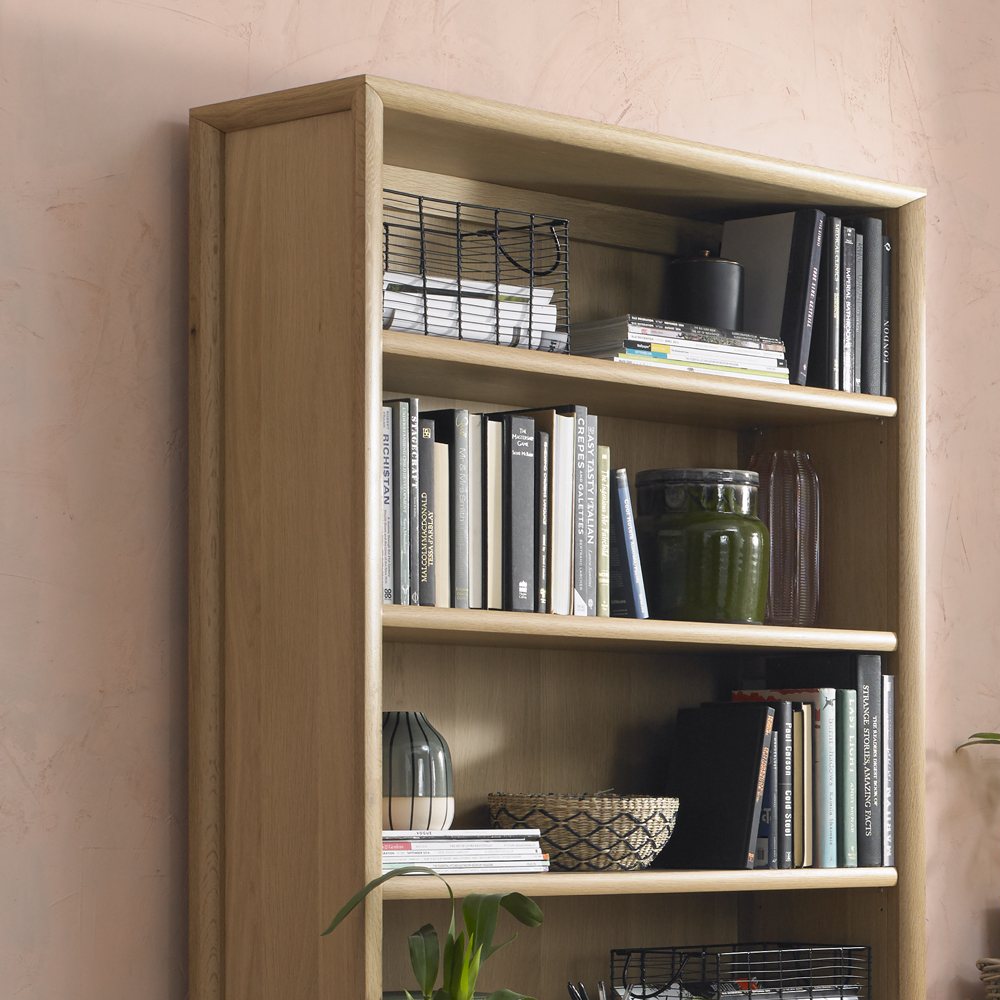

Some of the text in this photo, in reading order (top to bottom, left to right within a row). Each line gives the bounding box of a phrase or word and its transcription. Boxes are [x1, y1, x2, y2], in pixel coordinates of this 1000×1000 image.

[459, 447, 466, 462] Mr
[577, 418, 585, 469] CREPES
[587, 426, 595, 544] EASY TASTY ITALIAN
[862, 685, 873, 837] STRANGE STORIES, AMAZING FACTS
[784, 790, 792, 836] Cold Steel
